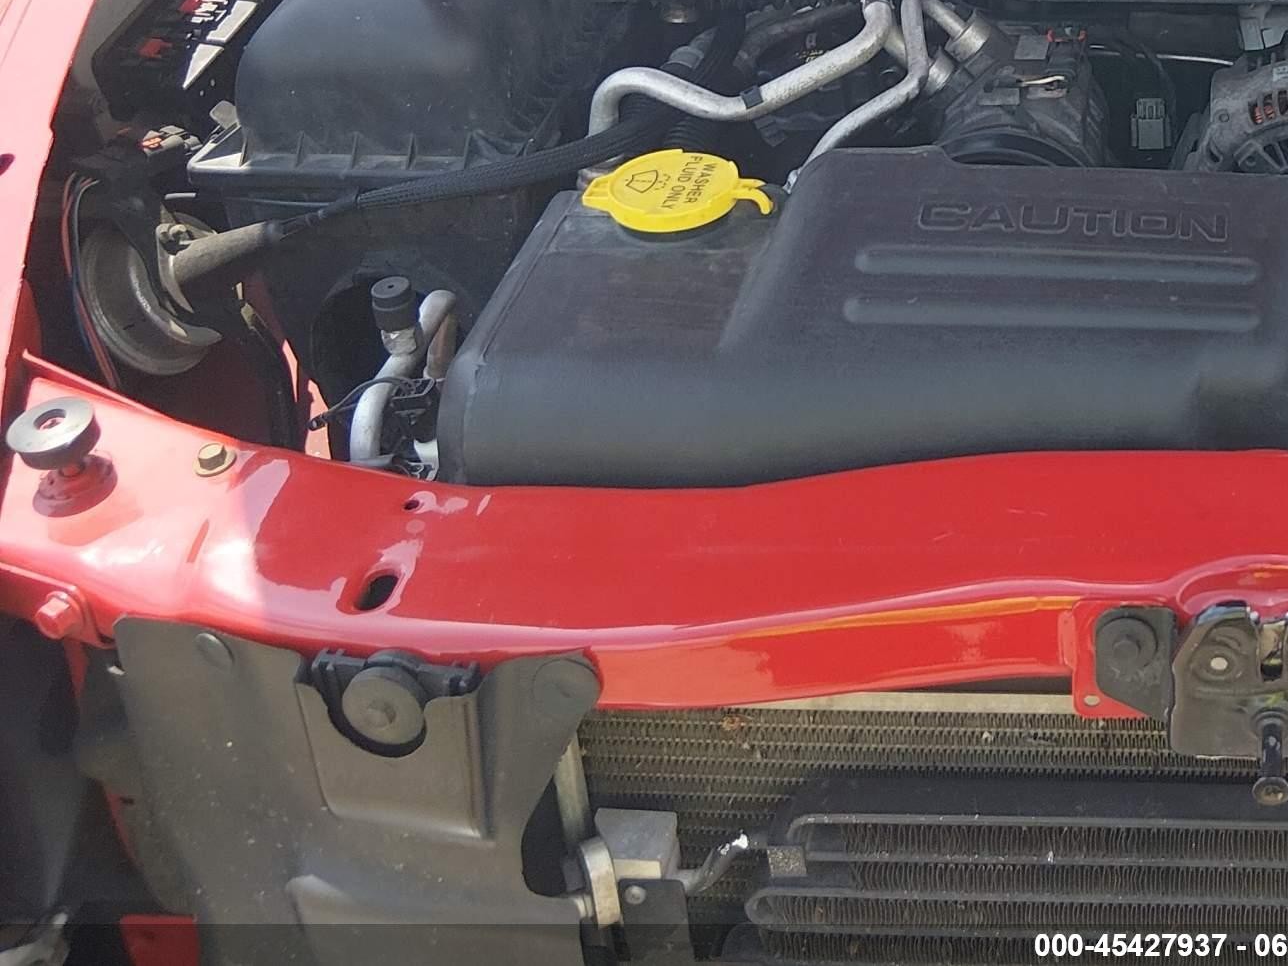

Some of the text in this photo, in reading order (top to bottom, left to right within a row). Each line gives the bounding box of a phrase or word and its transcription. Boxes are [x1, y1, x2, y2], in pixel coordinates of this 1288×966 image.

[660, 155, 704, 210] FLUID ONLY
[685, 161, 718, 205] WASHER
[917, 201, 1229, 243] CAUTION
